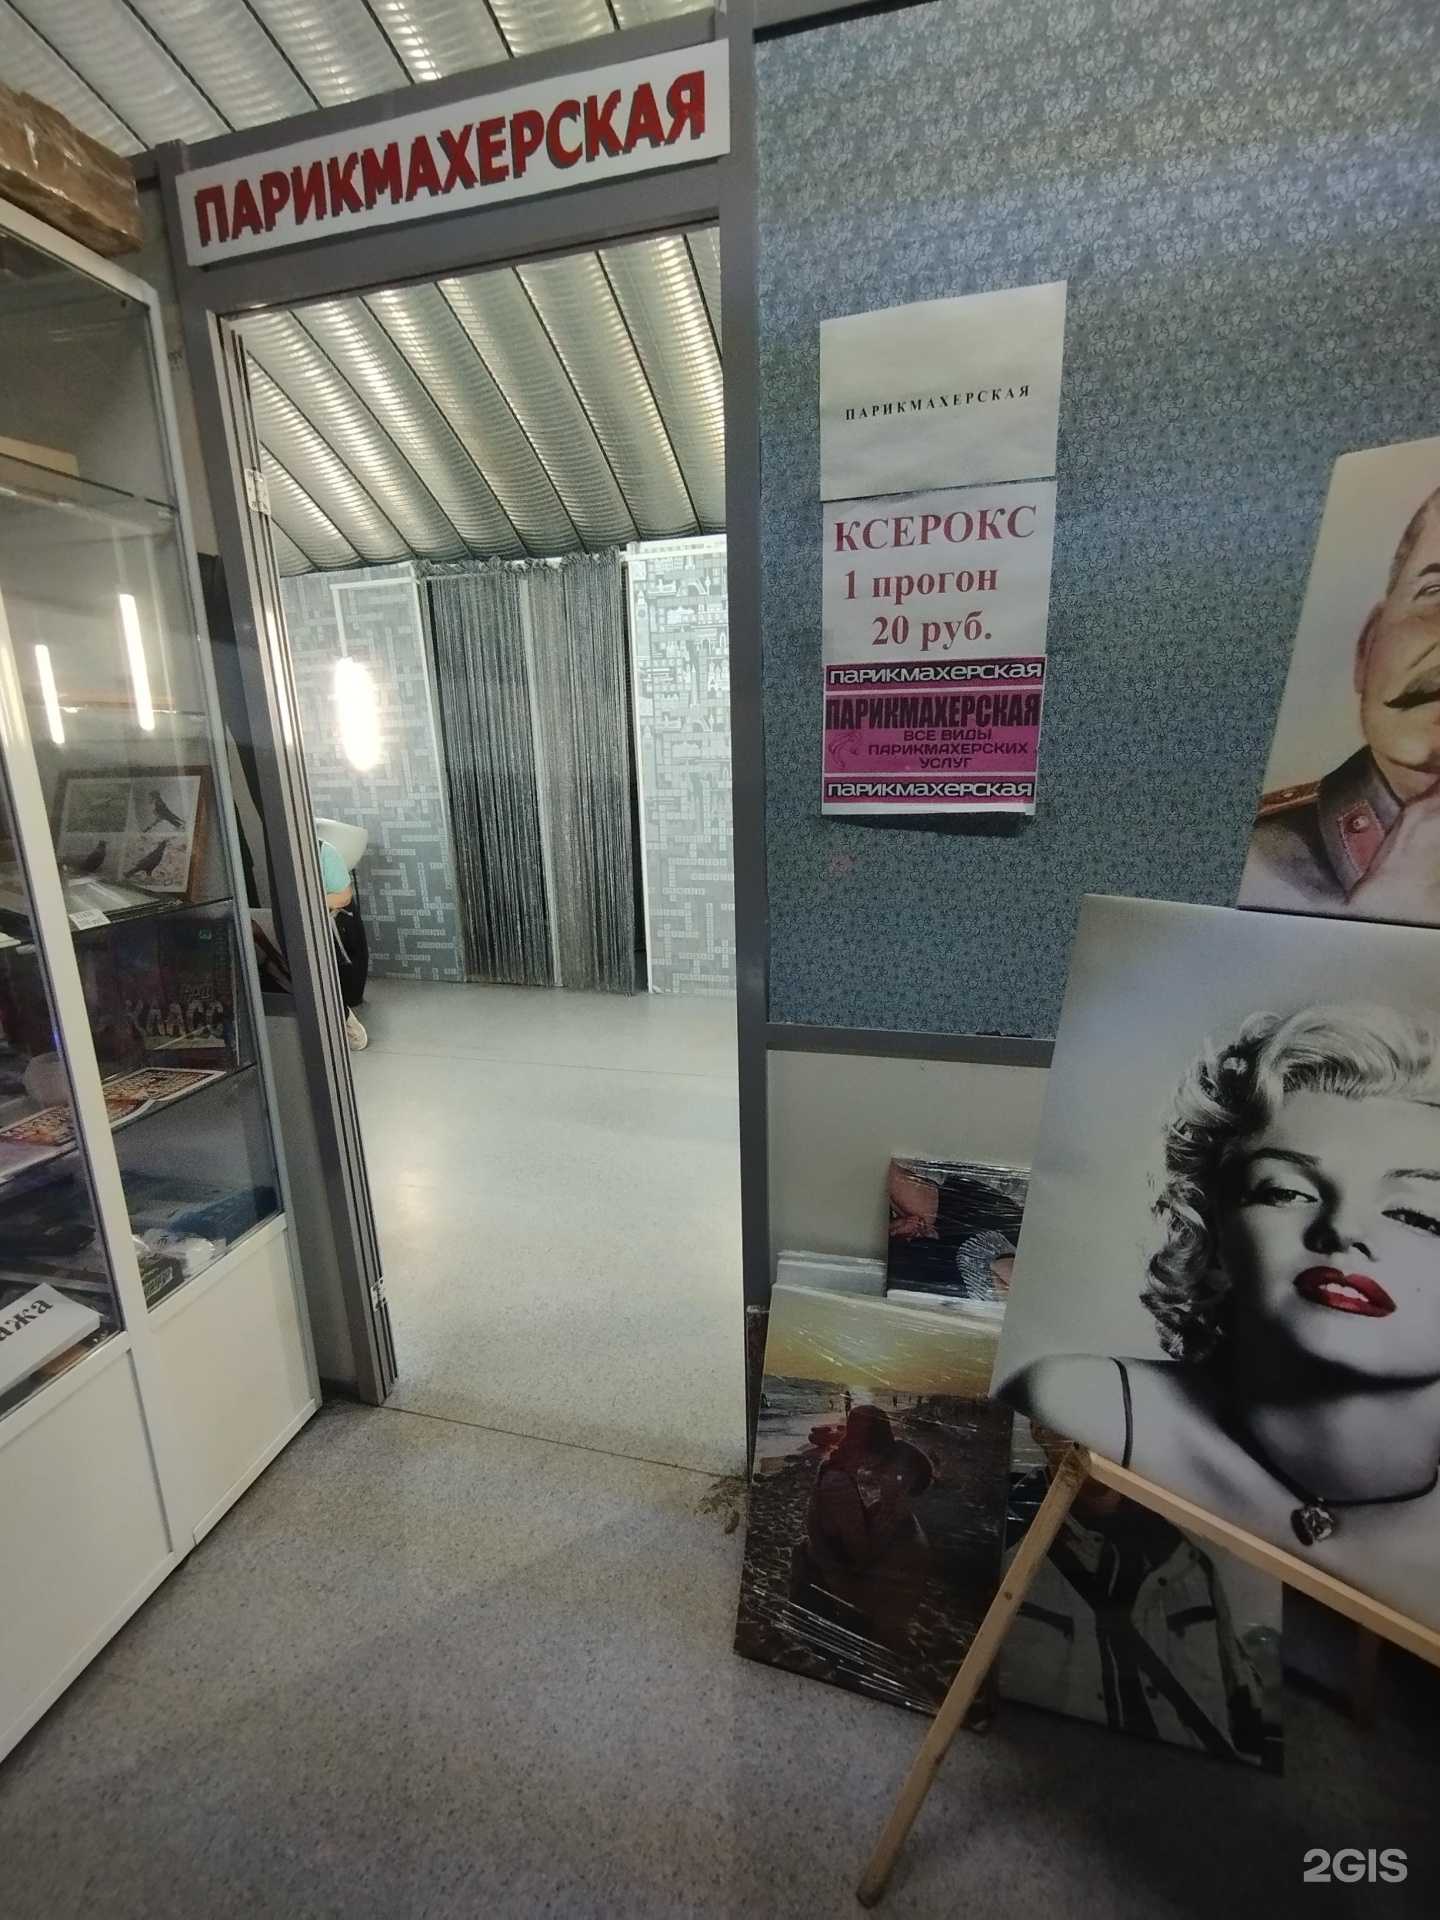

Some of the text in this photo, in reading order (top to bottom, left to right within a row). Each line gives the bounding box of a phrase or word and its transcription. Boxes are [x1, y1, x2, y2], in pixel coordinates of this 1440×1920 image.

[193, 70, 707, 247] ПАРИКМАХЕРСКАЯ
[845, 385, 1031, 421] ПАРИКМАХЕРСКАЯ
[834, 505, 1037, 552] КСЕРОКС
[845, 569, 998, 605] 1 прогон
[872, 608, 993, 651] 20 руб.
[829, 663, 1043, 685] парикмахерская
[825, 693, 1043, 730] ПАРИКМАХЕРСКАЯ
[868, 742, 1029, 756] ПАРИКМАХЕРСКИХ
[903, 729, 993, 742] ВСЕ ВИДЫ
[919, 757, 974, 769] УСЛУГ
[827, 783, 1034, 797] парикмахерская
